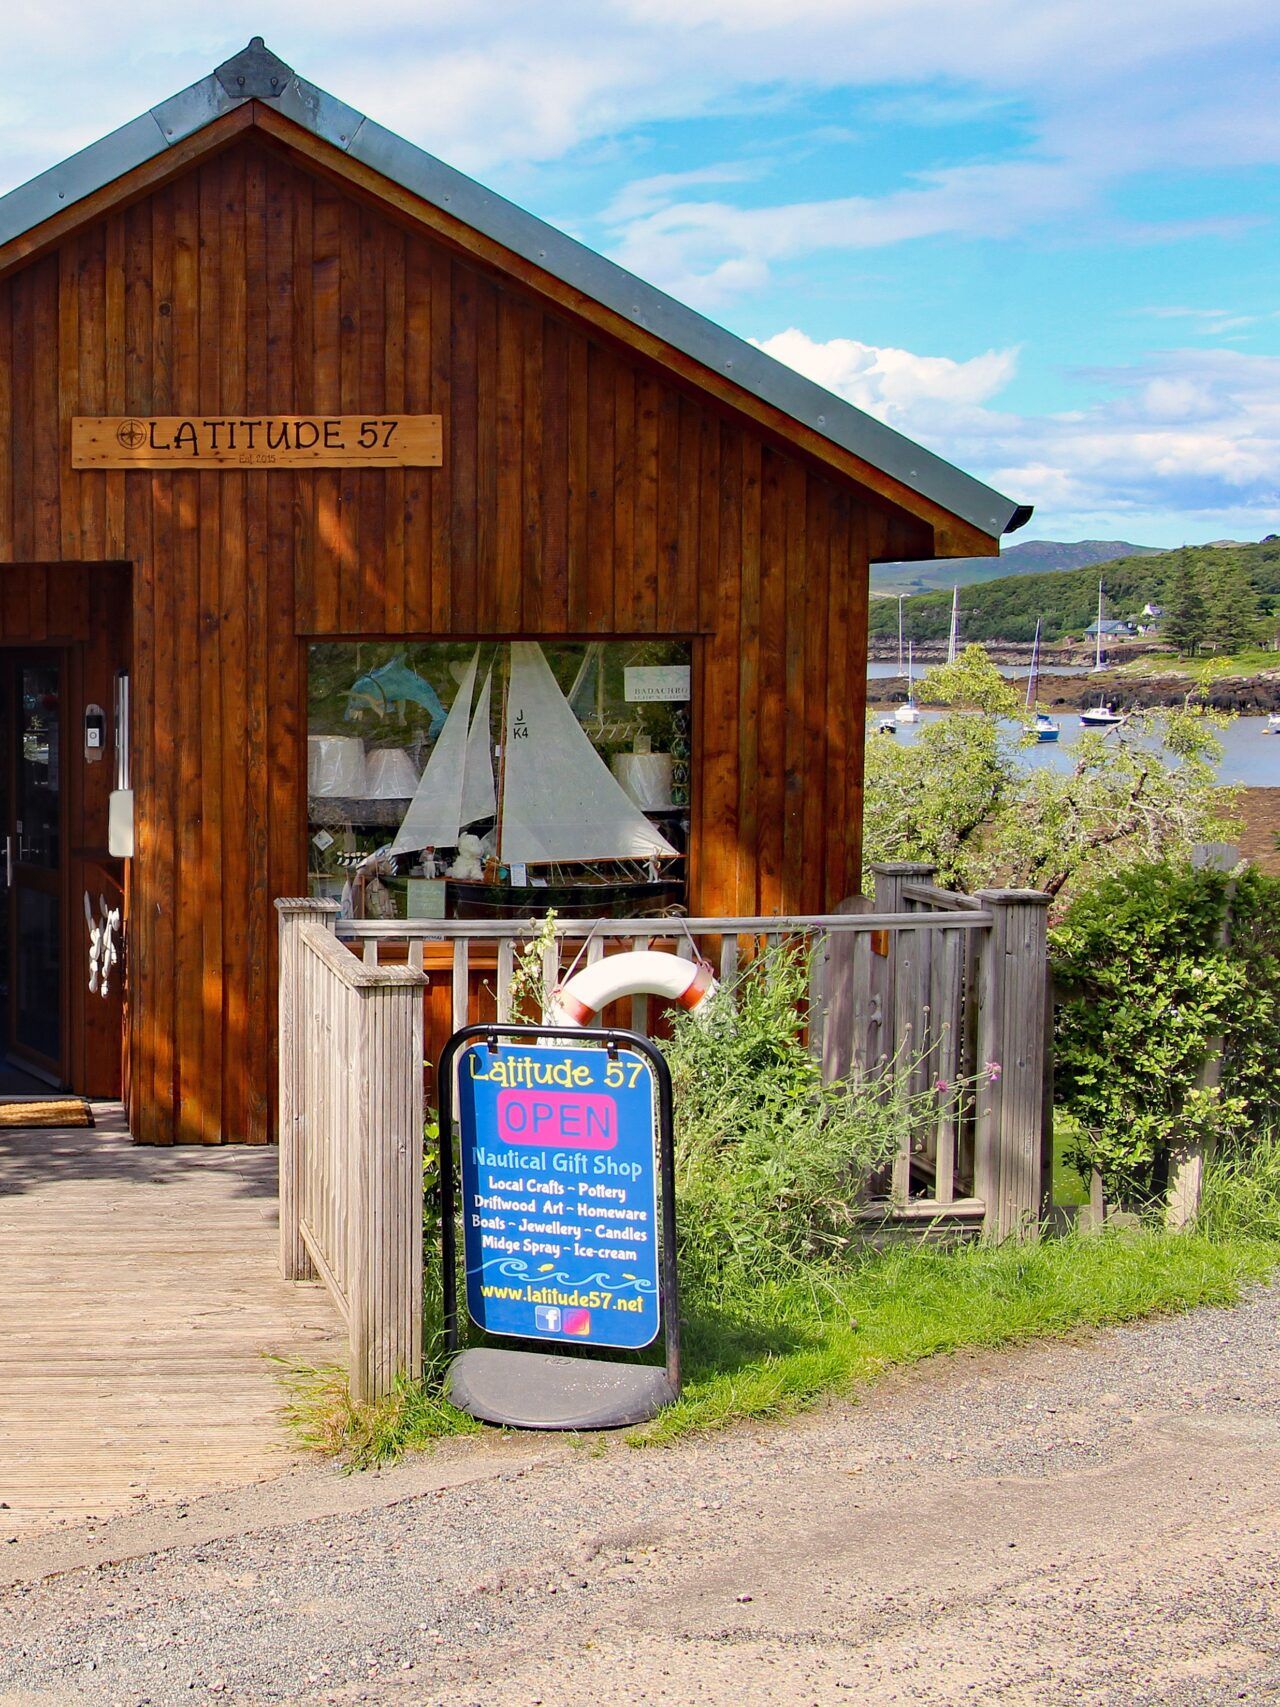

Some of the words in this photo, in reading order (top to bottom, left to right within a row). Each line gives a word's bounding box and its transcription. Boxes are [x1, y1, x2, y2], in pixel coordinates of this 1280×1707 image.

[148, 421, 345, 456] LATITUDE
[357, 421, 399, 449] 57
[256, 454, 276, 464] 2015
[634, 687, 688, 695] BADACHRO
[516, 709, 524, 721] J
[513, 727, 528, 739] K4
[468, 1054, 594, 1088] Latitude
[603, 1061, 643, 1088] 57
[505, 1101, 610, 1138] OPEN
[472, 1147, 546, 1171] Nautical
[552, 1152, 588, 1174] Gift
[593, 1155, 643, 1182] Shop
[488, 1176, 523, 1192] Local
[526, 1178, 565, 1195] Crafts
[578, 1182, 626, 1203] Pottery
[474, 1194, 536, 1212] Driftwood
[543, 1200, 564, 1215] Art
[577, 1203, 647, 1221] Homeware
[472, 1214, 506, 1230] Boats
[518, 1218, 581, 1240] Jewellery
[595, 1224, 647, 1241] Candles
[481, 1235, 520, 1254] Midge
[523, 1238, 560, 1258] Spray
[574, 1243, 637, 1261] Ice-cream
[480, 1283, 644, 1313] www.latitude57.net
